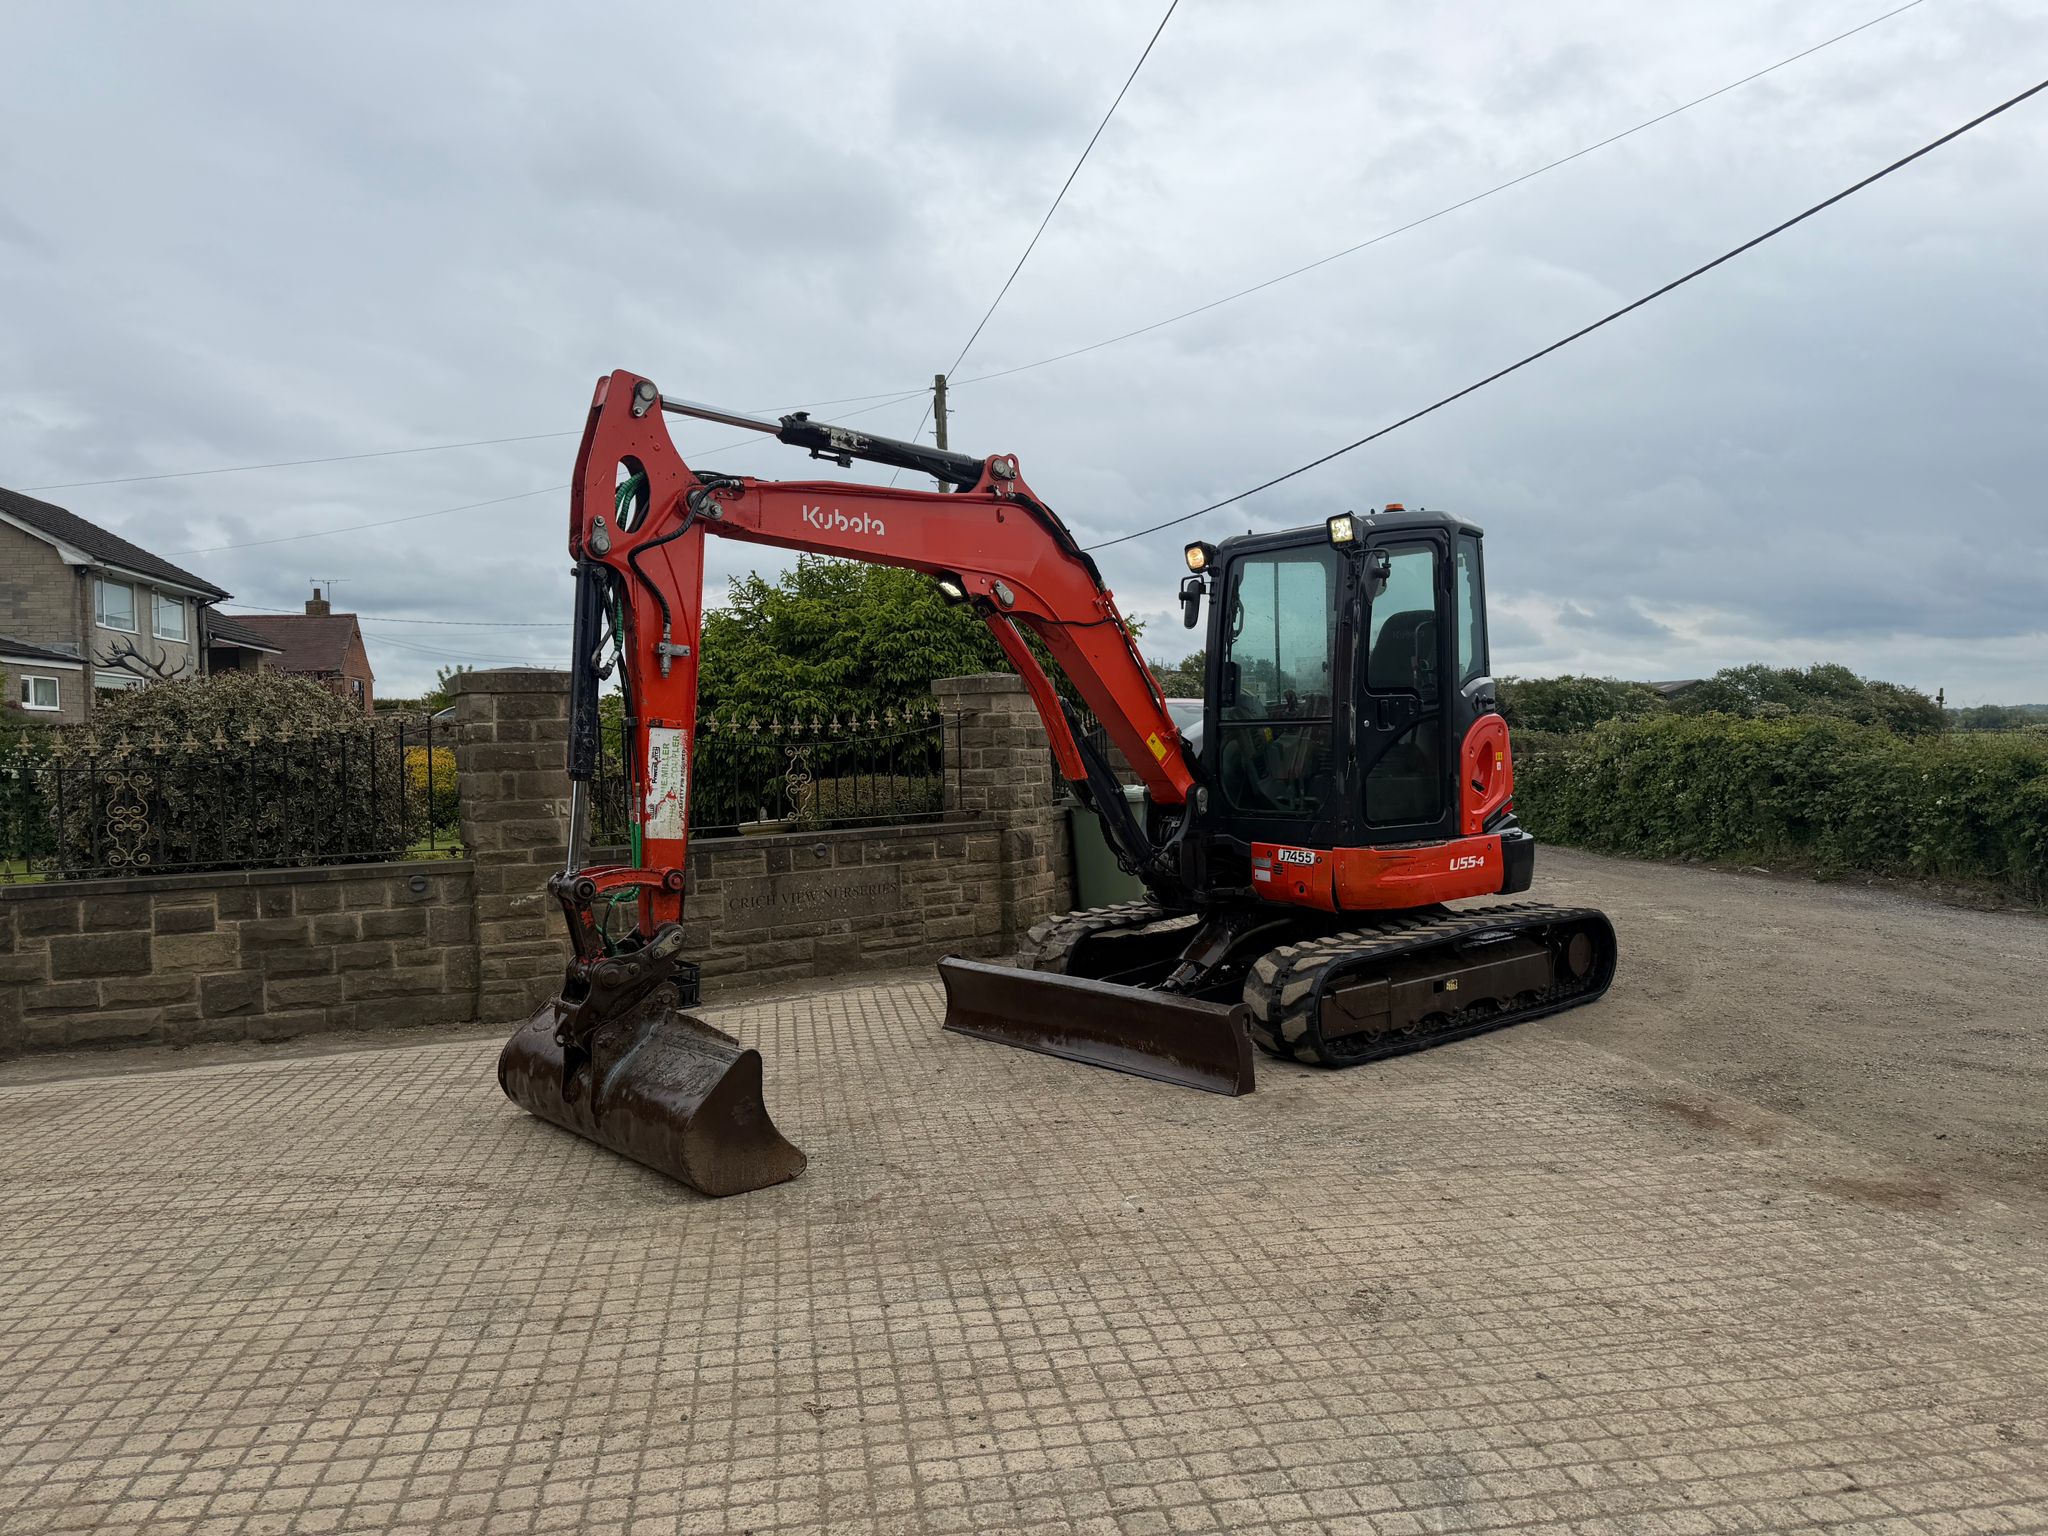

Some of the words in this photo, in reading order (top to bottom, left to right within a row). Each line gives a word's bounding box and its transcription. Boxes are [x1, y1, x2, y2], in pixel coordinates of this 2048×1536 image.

[802, 504, 885, 536] Kubota
[1281, 850, 1312, 863] J7455
[729, 894, 777, 910] CRICH
[782, 889, 817, 905] VIEW
[823, 882, 897, 899] NURSERIES
